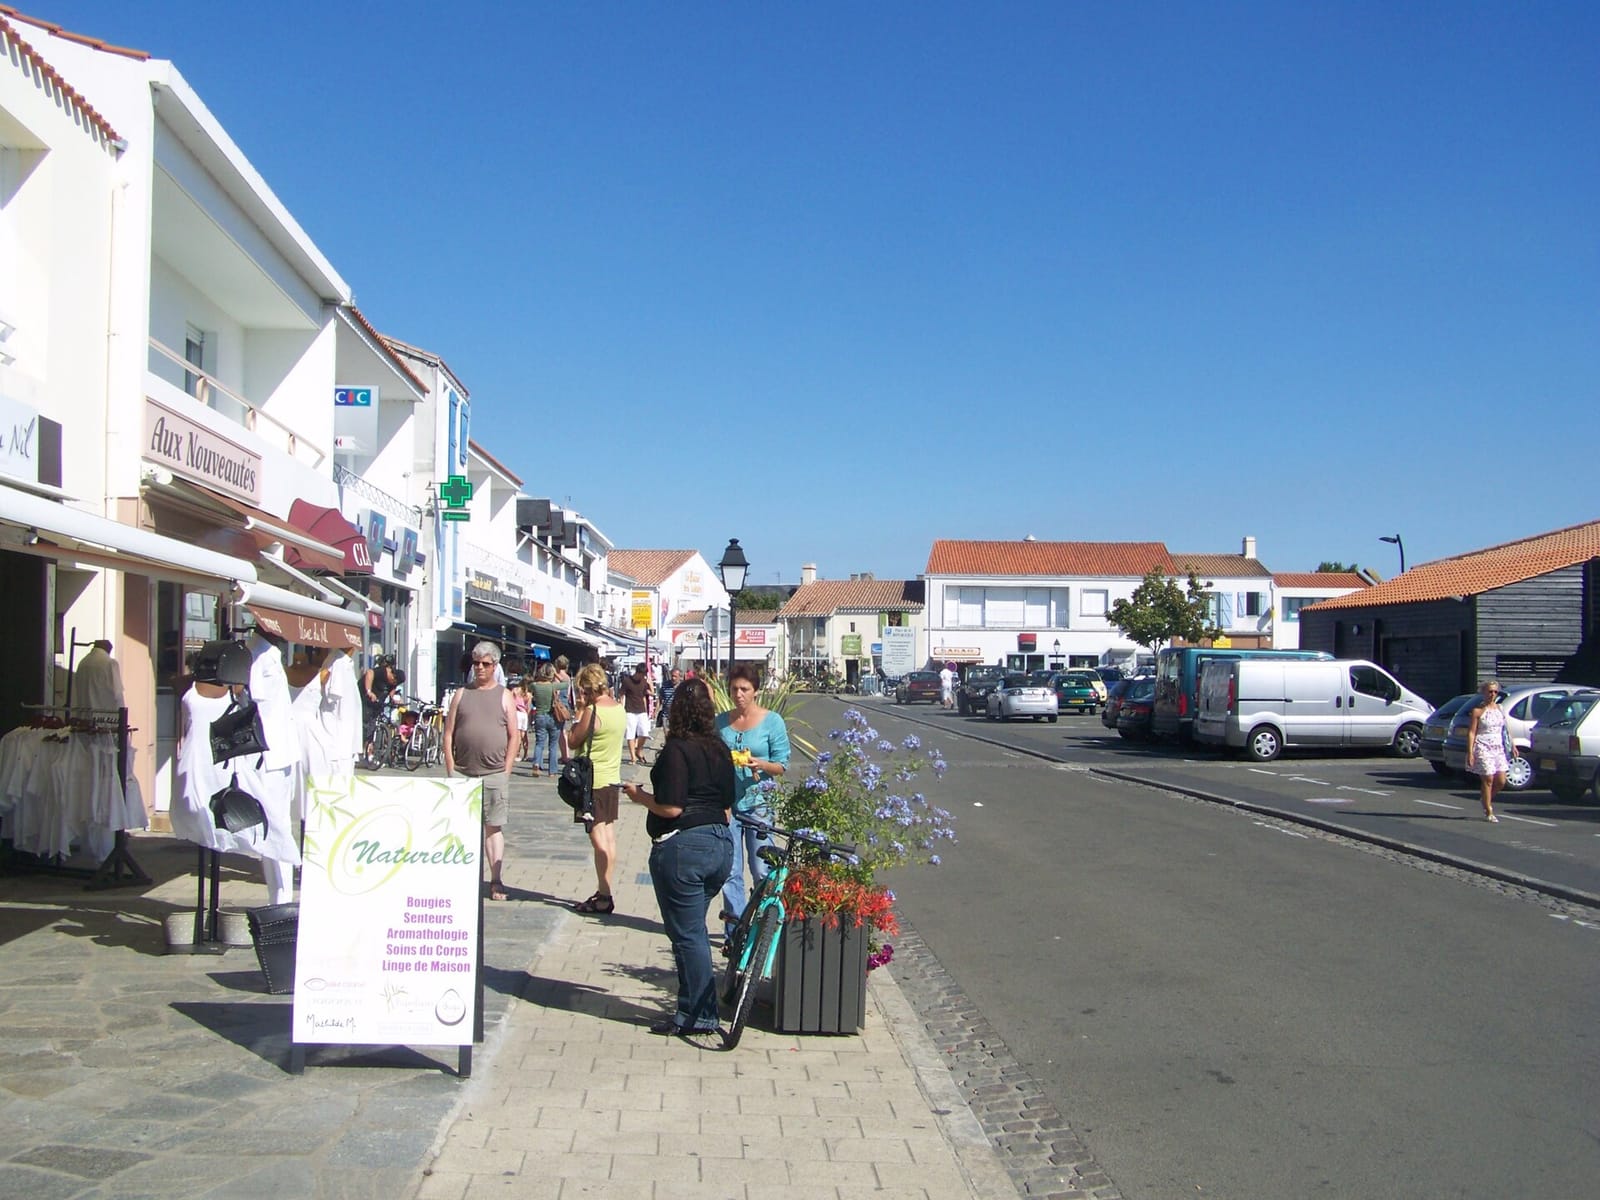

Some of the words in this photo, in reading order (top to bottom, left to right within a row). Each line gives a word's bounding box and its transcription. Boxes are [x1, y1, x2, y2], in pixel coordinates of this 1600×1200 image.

[335, 391, 369, 404] CIC
[9, 416, 36, 460] Nil
[150, 415, 183, 462] Aux
[186, 430, 257, 494] Nouveautés
[352, 839, 475, 865] Naturelle
[406, 896, 452, 910] Bougies
[403, 912, 453, 925] Senteurs
[386, 927, 469, 942] Aromathologie
[386, 943, 417, 956] Soins
[419, 944, 434, 956] du
[435, 944, 468, 957] Corps
[382, 959, 412, 973] Linge
[414, 960, 428, 972] de
[430, 960, 471, 973] Maison
